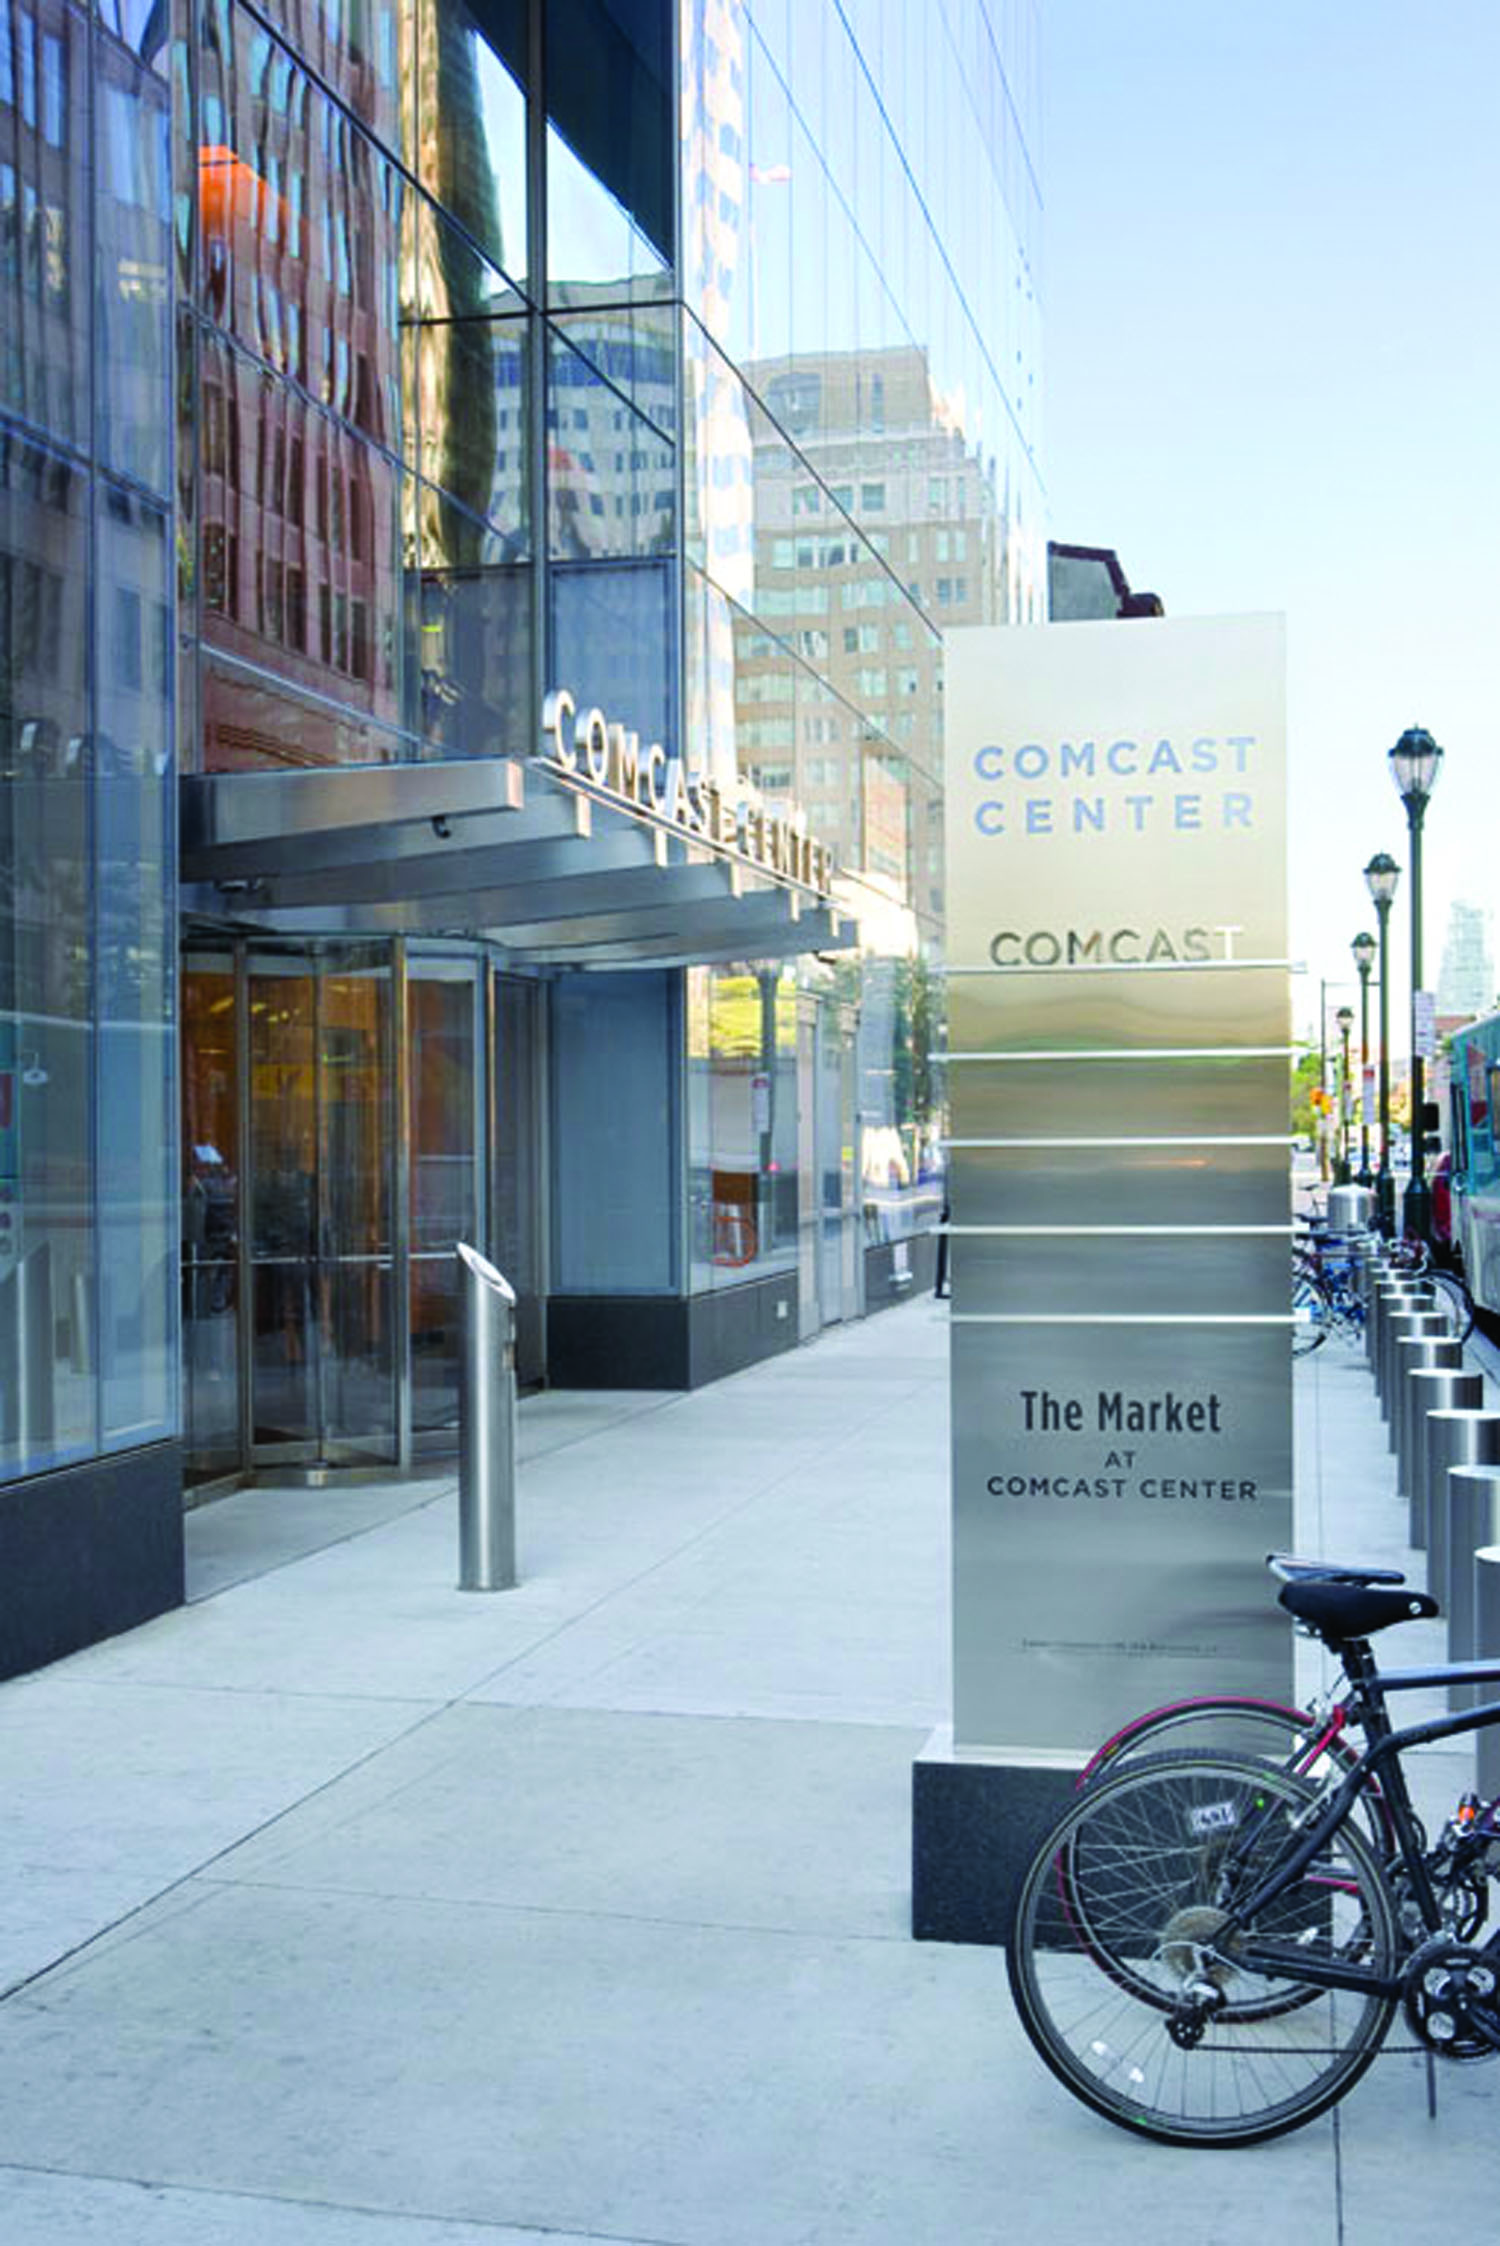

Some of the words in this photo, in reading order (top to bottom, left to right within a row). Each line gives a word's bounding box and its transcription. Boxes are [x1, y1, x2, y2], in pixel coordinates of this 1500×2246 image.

[543, 690, 730, 844] COMCAST
[974, 737, 1256, 781] COMCAST
[974, 793, 1253, 835] CENTER
[989, 926, 1242, 965] COMCAST
[1020, 1390, 1083, 1432] The
[1097, 1391, 1222, 1433] Market
[1103, 1450, 1136, 1469] AT
[986, 1475, 1126, 1498] COMCAST
[1139, 1478, 1258, 1501] CENTER
